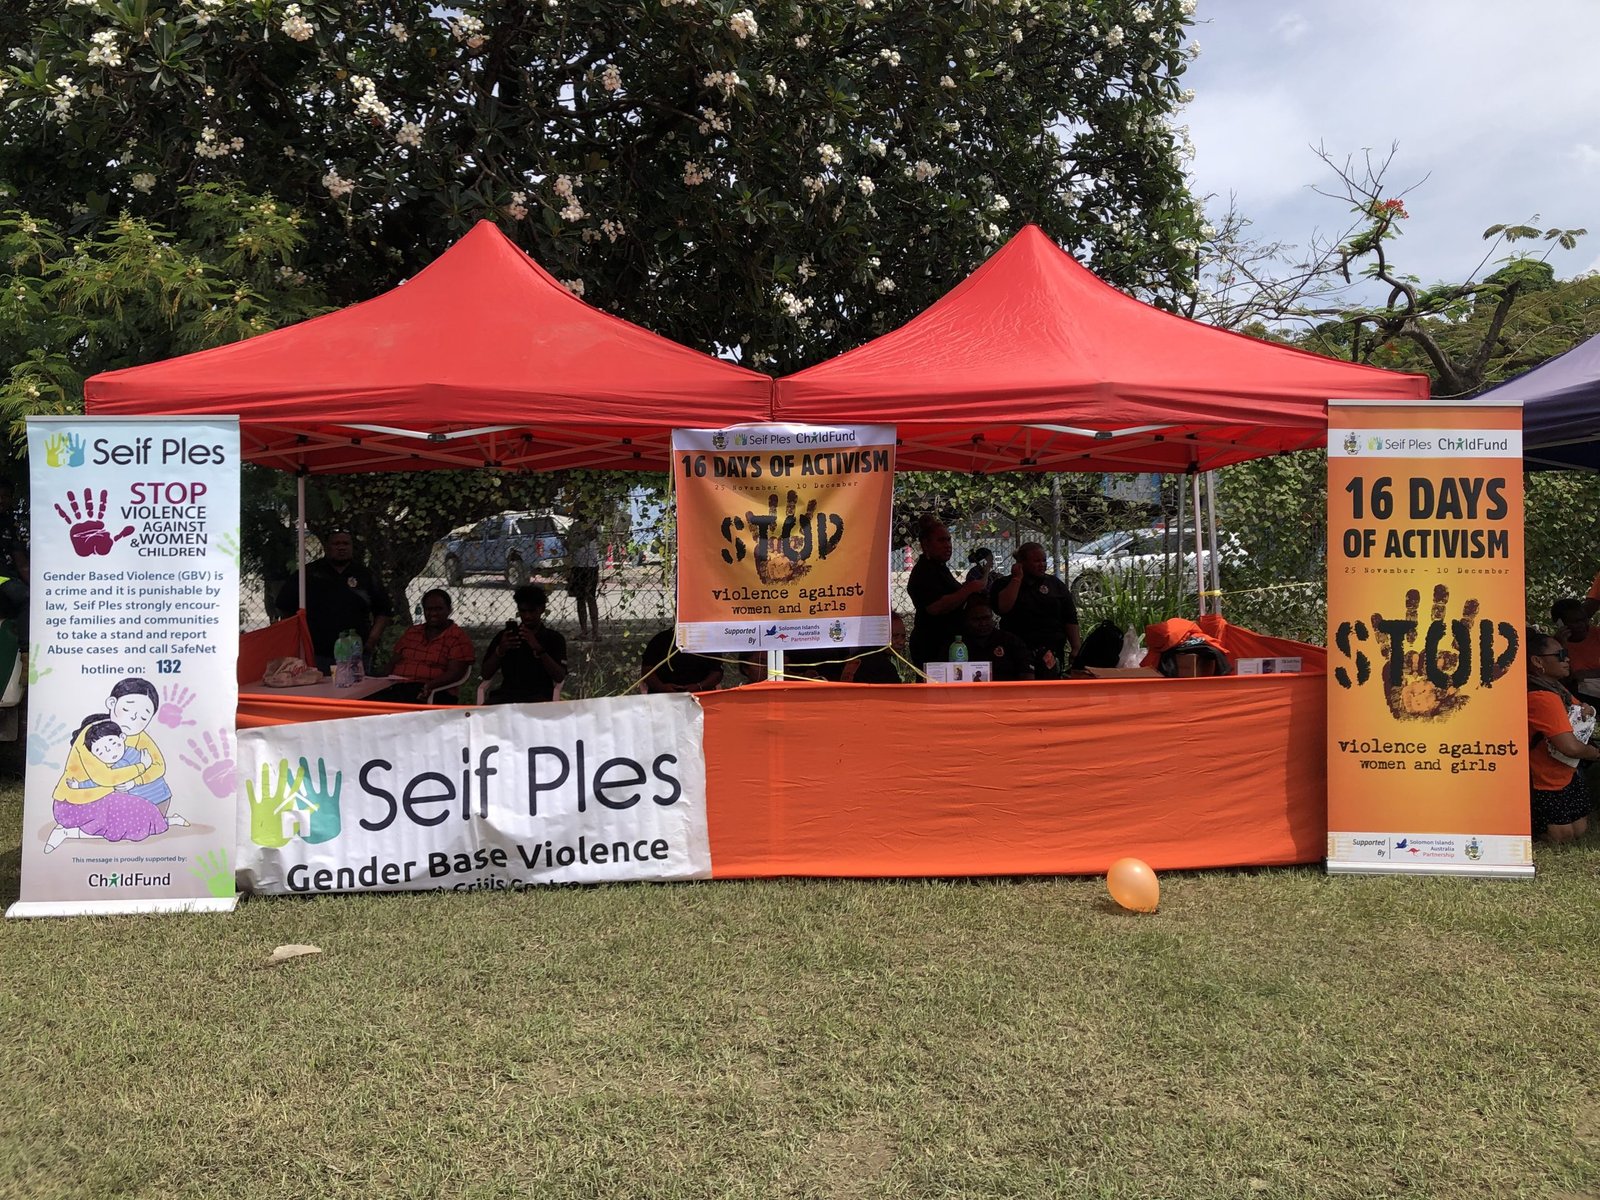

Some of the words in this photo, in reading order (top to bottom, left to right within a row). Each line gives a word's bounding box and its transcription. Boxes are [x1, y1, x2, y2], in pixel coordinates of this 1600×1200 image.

[750, 434, 768, 444] Seif
[770, 434, 790, 444] Ples
[1386, 438, 1406, 450] Seif
[1408, 438, 1432, 450] Ples
[93, 437, 152, 466] Seif
[162, 437, 225, 466] Ples
[682, 455, 706, 478] 16
[714, 454, 762, 478] DAYS
[770, 454, 795, 477] OF
[802, 450, 888, 476] ACTIVISM
[814, 481, 858, 489] December
[130, 482, 207, 504] STOP
[1345, 476, 1393, 520] 16
[1409, 477, 1508, 520] DAYS
[121, 506, 206, 520] VIOLENCE
[143, 522, 205, 532] AGAINST
[1343, 528, 1376, 558] OF
[1384, 529, 1508, 558] ACTIVISM
[138, 547, 206, 556] CHILDREN
[43, 572, 86, 582] Gender
[88, 572, 124, 581] Based
[126, 572, 175, 581] Violence
[178, 571, 211, 582] (GBV)
[214, 572, 224, 581] is
[54, 586, 87, 596] crime
[90, 586, 112, 596] and
[116, 586, 124, 596] it
[127, 586, 136, 596] is
[139, 586, 202, 598] punishable
[206, 586, 220, 598] by
[712, 586, 788, 600] violence
[800, 583, 864, 600] against
[46, 601, 68, 612] law,
[74, 600, 96, 610] Seif
[98, 600, 122, 610] Ples
[126, 600, 172, 614] strongly
[174, 602, 220, 610] encour-
[732, 604, 770, 614] women
[778, 602, 801, 613] and
[810, 601, 846, 615] girls
[46, 617, 66, 628] age
[70, 614, 116, 625] families
[118, 614, 141, 625] and
[144, 615, 219, 625] communities
[57, 630, 68, 640] to
[72, 630, 97, 640] take
[110, 630, 143, 640] stand
[146, 630, 168, 640] and
[170, 630, 207, 642] report
[48, 644, 84, 654] Abuse
[86, 646, 118, 654] cases
[124, 644, 146, 654] and
[150, 644, 168, 654] call
[171, 644, 216, 654] SafeNet
[82, 664, 124, 674] hotline
[127, 666, 146, 674] on:
[156, 660, 182, 674] 132
[1338, 738, 1426, 754] violence
[1439, 740, 1518, 758] against
[1360, 760, 1406, 770] women
[1414, 759, 1442, 770] and
[1451, 760, 1496, 774] girls
[359, 745, 500, 832] Seif
[528, 739, 682, 817] Ples
[1352, 838, 1386, 846] Supported
[1378, 849, 1386, 857] By
[287, 856, 416, 893] Gender
[429, 845, 508, 878] Base
[516, 837, 669, 870] Violence
